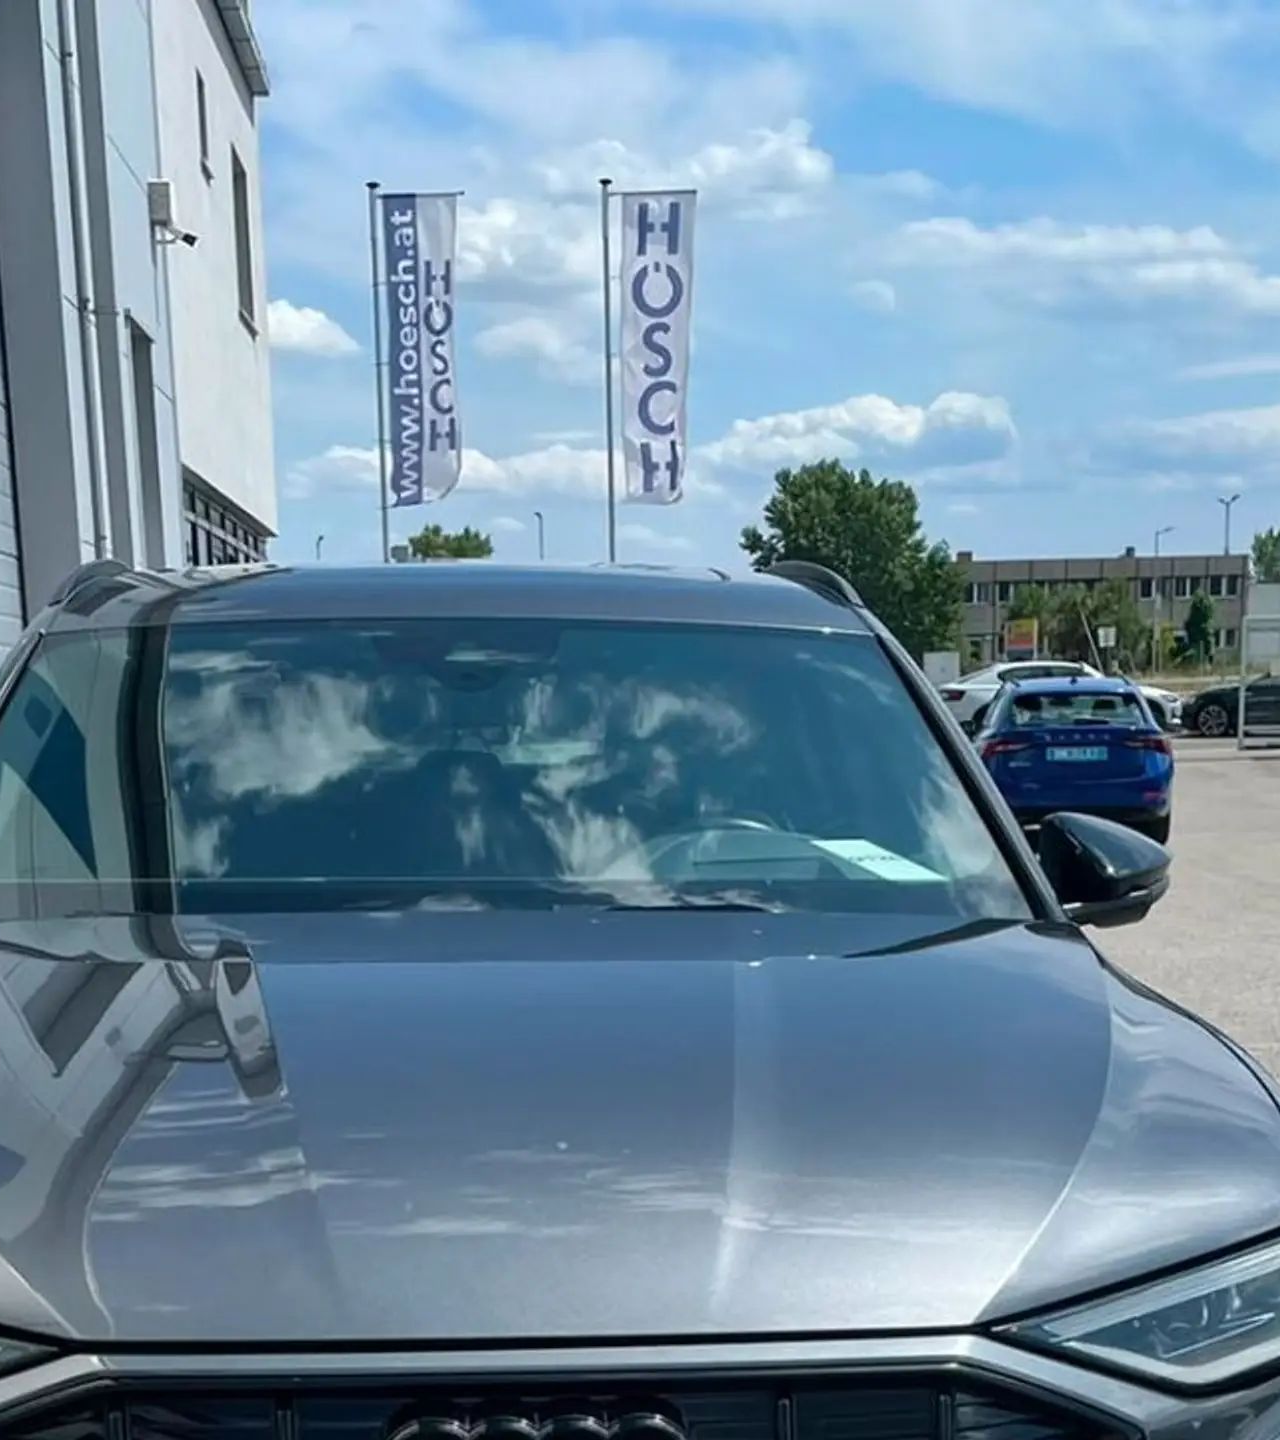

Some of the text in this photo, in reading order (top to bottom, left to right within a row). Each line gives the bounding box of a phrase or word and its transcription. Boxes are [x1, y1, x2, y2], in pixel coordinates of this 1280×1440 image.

[390, 208, 419, 498] www.hoesch.at
[423, 258, 457, 452] HÖSCH
[631, 201, 684, 494] HÖSCH
